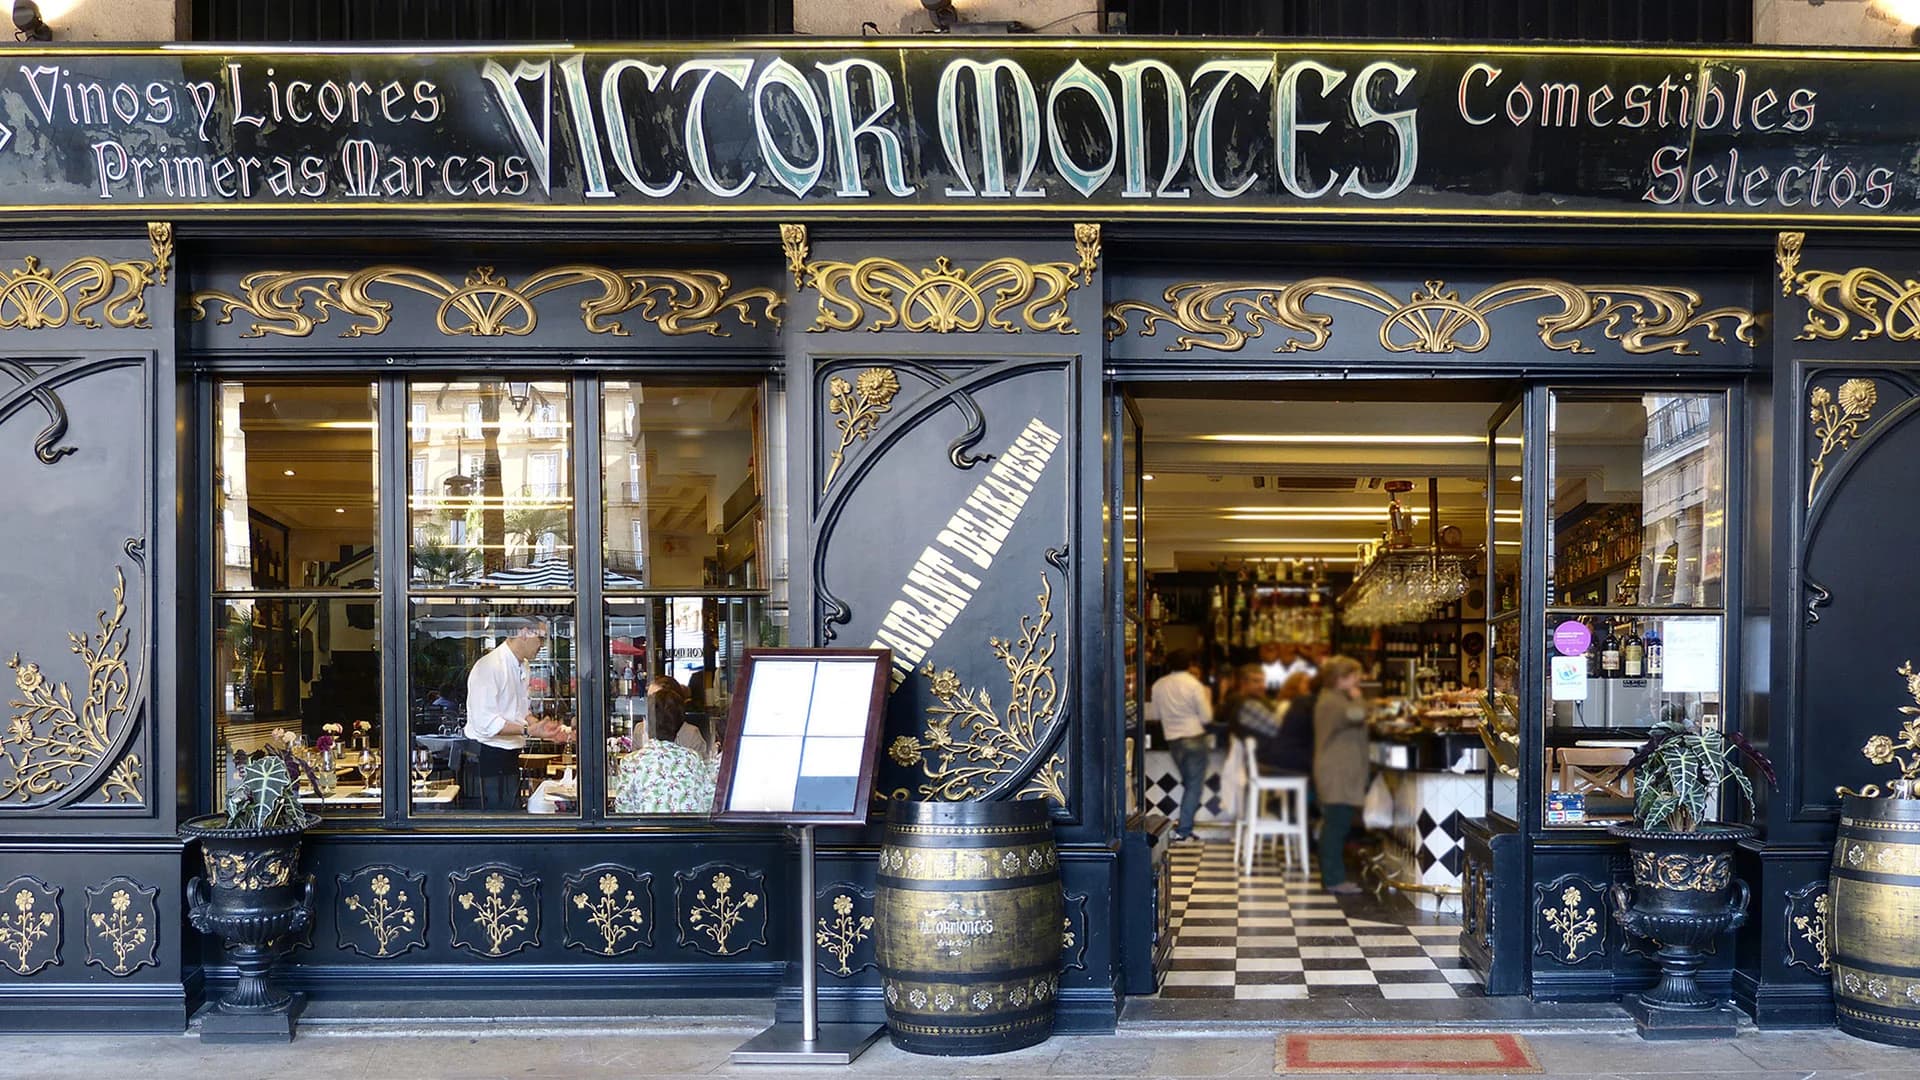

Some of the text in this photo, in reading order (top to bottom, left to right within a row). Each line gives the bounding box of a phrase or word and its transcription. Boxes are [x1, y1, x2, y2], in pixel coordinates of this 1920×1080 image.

[20, 63, 441, 142] Vinos y Licores
[481, 52, 1419, 200] VICTOR MONTES
[1458, 62, 1818, 132] Comestibles
[91, 138, 531, 199] Primeras Marcas
[1641, 145, 1895, 209] Selectos
[869, 417, 1062, 694] TAURANT DELIKATESSEN
